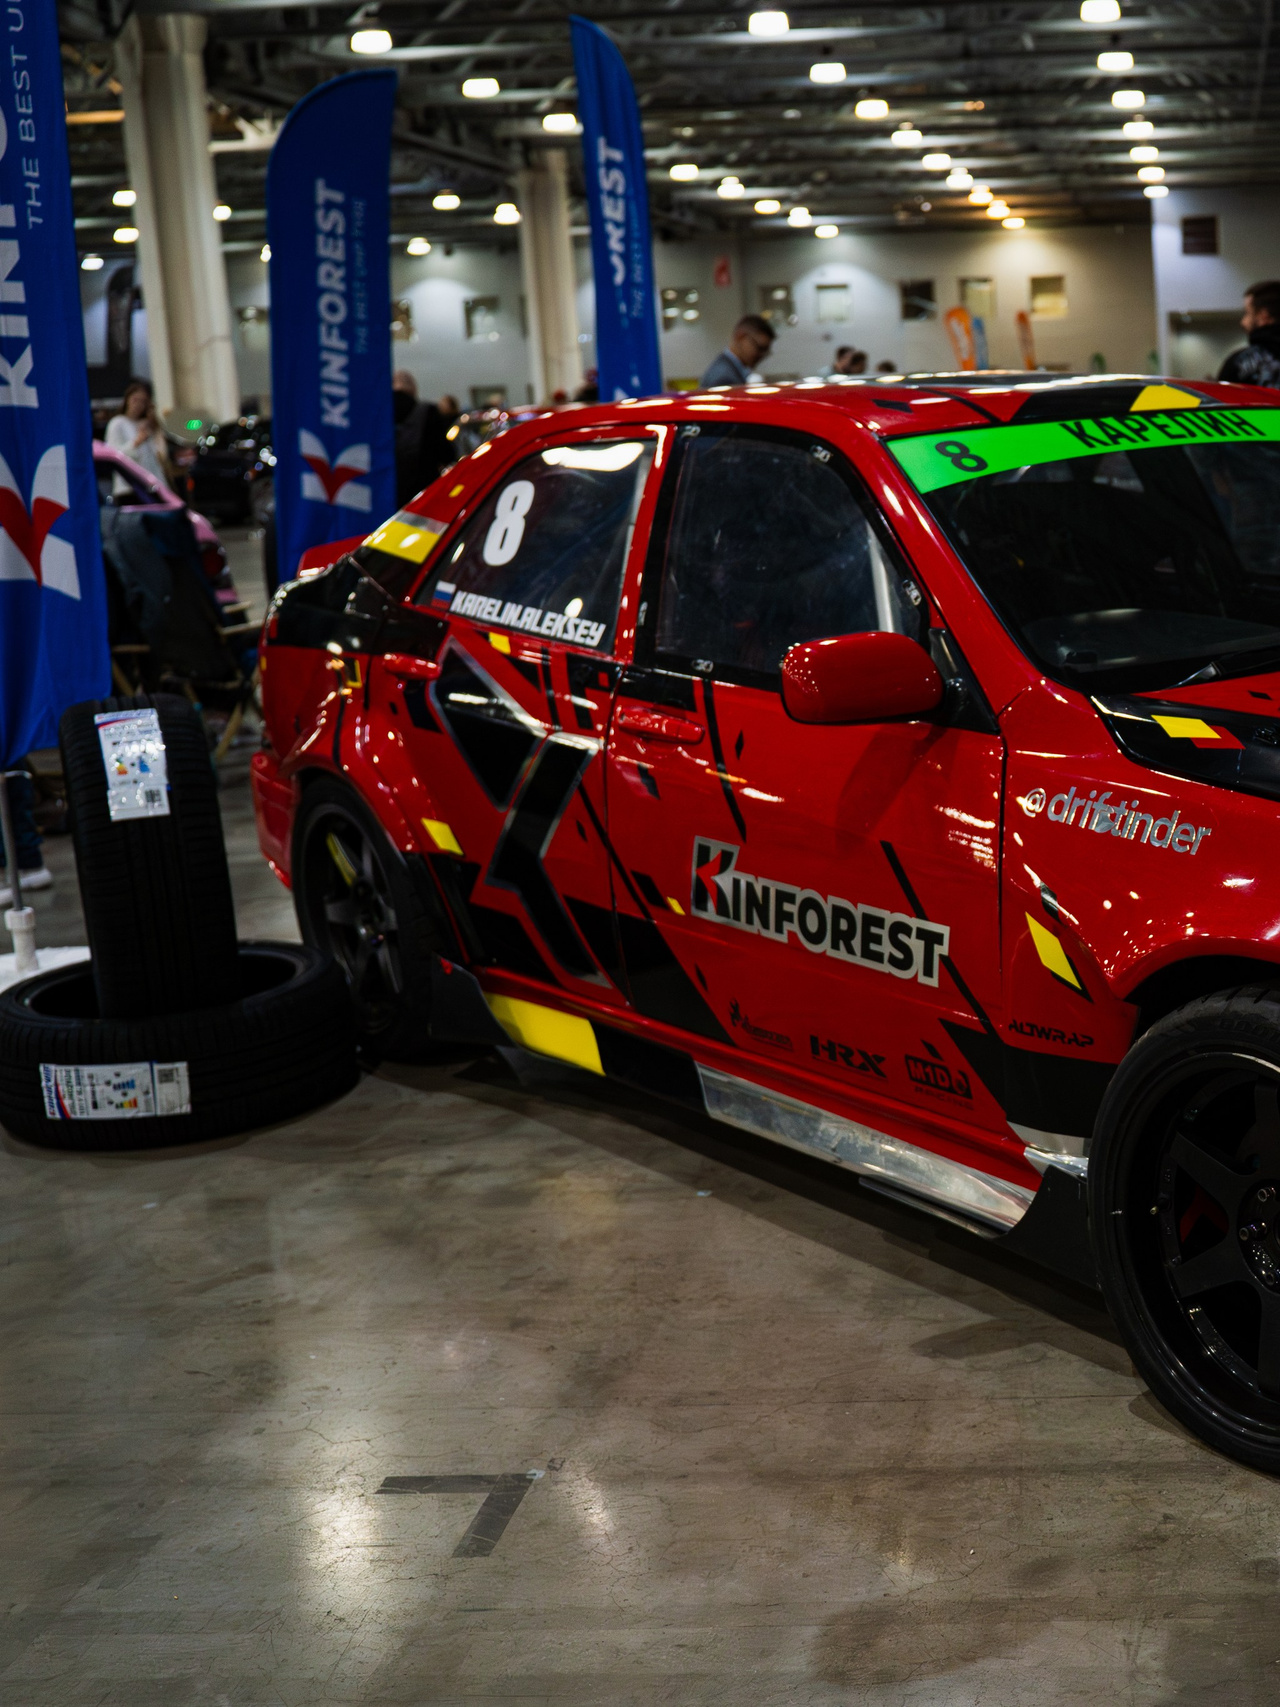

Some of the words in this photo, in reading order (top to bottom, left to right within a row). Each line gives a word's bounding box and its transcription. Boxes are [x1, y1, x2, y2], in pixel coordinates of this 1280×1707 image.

[11, 45, 37, 143] BEST
[23, 157, 43, 230] THE
[314, 177, 351, 429] KINFOREST
[935, 441, 987, 472] 8
[1060, 411, 1266, 449] КАРЕЛИН
[482, 479, 536, 567] 8
[449, 590, 607, 648] KARELIN.ALEKSEY
[694, 842, 946, 980] KINFOREST
[810, 1034, 887, 1079] HRX
